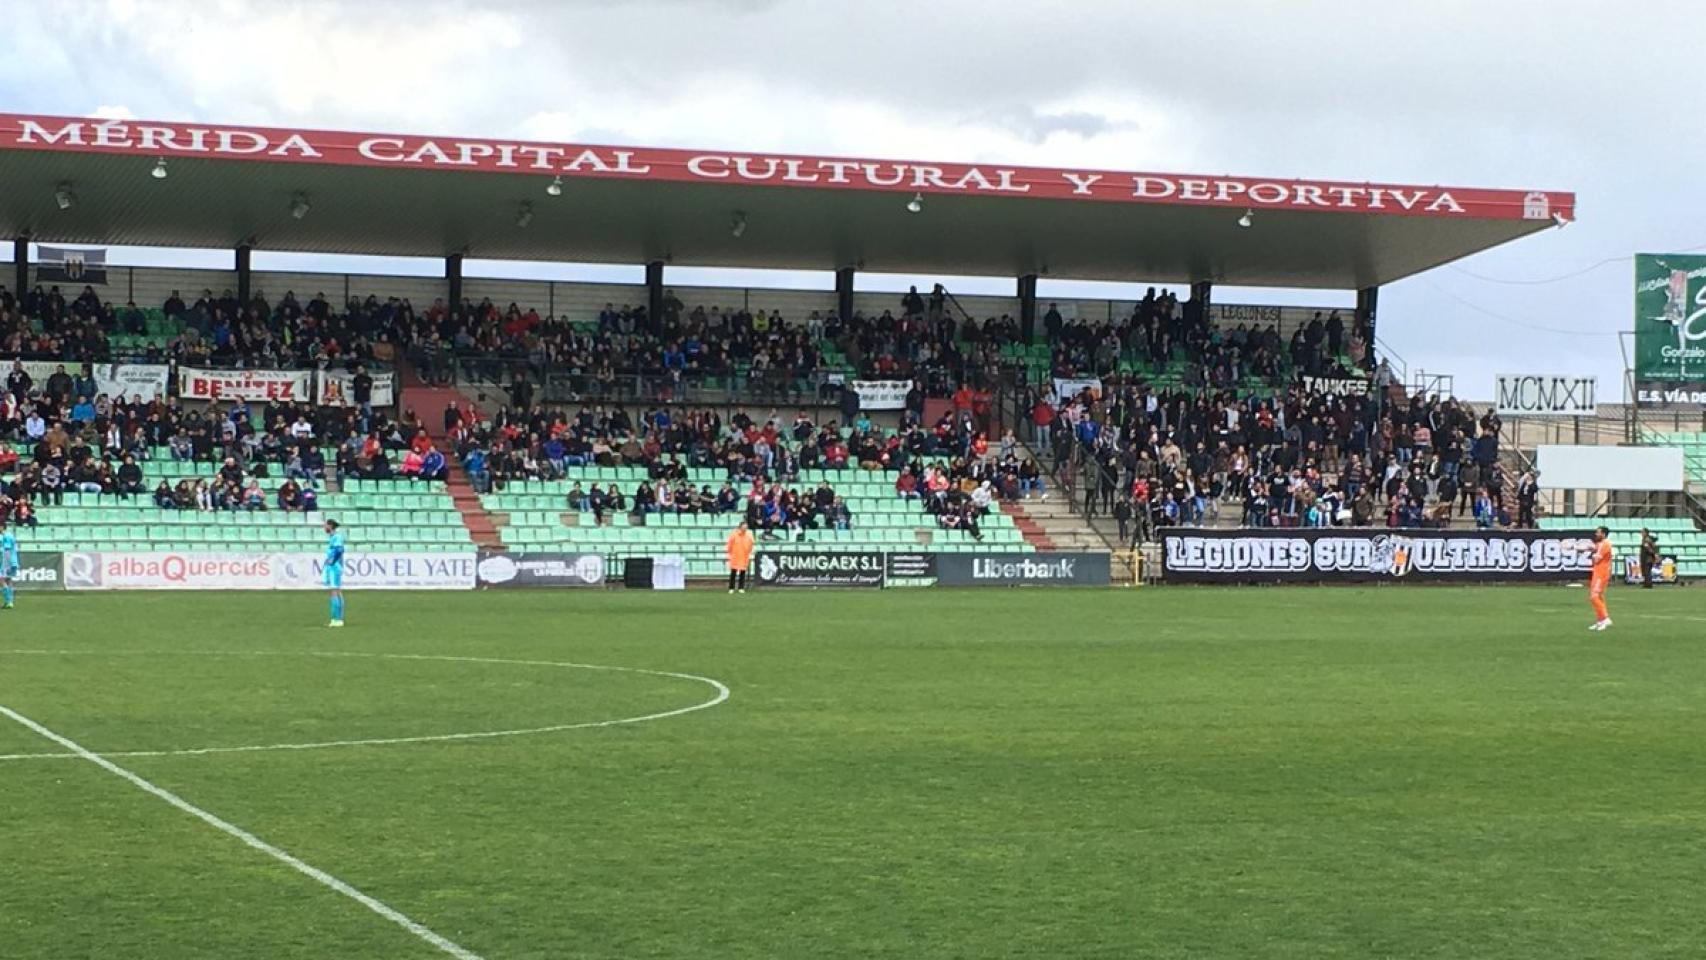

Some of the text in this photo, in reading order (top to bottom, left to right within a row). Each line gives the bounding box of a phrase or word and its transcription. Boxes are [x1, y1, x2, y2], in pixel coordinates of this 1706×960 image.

[16, 119, 1466, 213] MÉRIDA CAPITAL CULTURAL Y DEPORTIVA
[1499, 377, 1595, 411] MCMXII
[1664, 388, 1689, 403] VÍA
[312, 553, 473, 577] MSÓN EL YATE
[779, 555, 883, 571] FUMIGAEX S.L.
[1166, 537, 1312, 571] LEGIONES
[1314, 537, 1375, 571] SUR
[1412, 538, 1527, 572] ULTRAS
[108, 555, 271, 582] albaQuercus
[972, 558, 1075, 579] Liberbank
